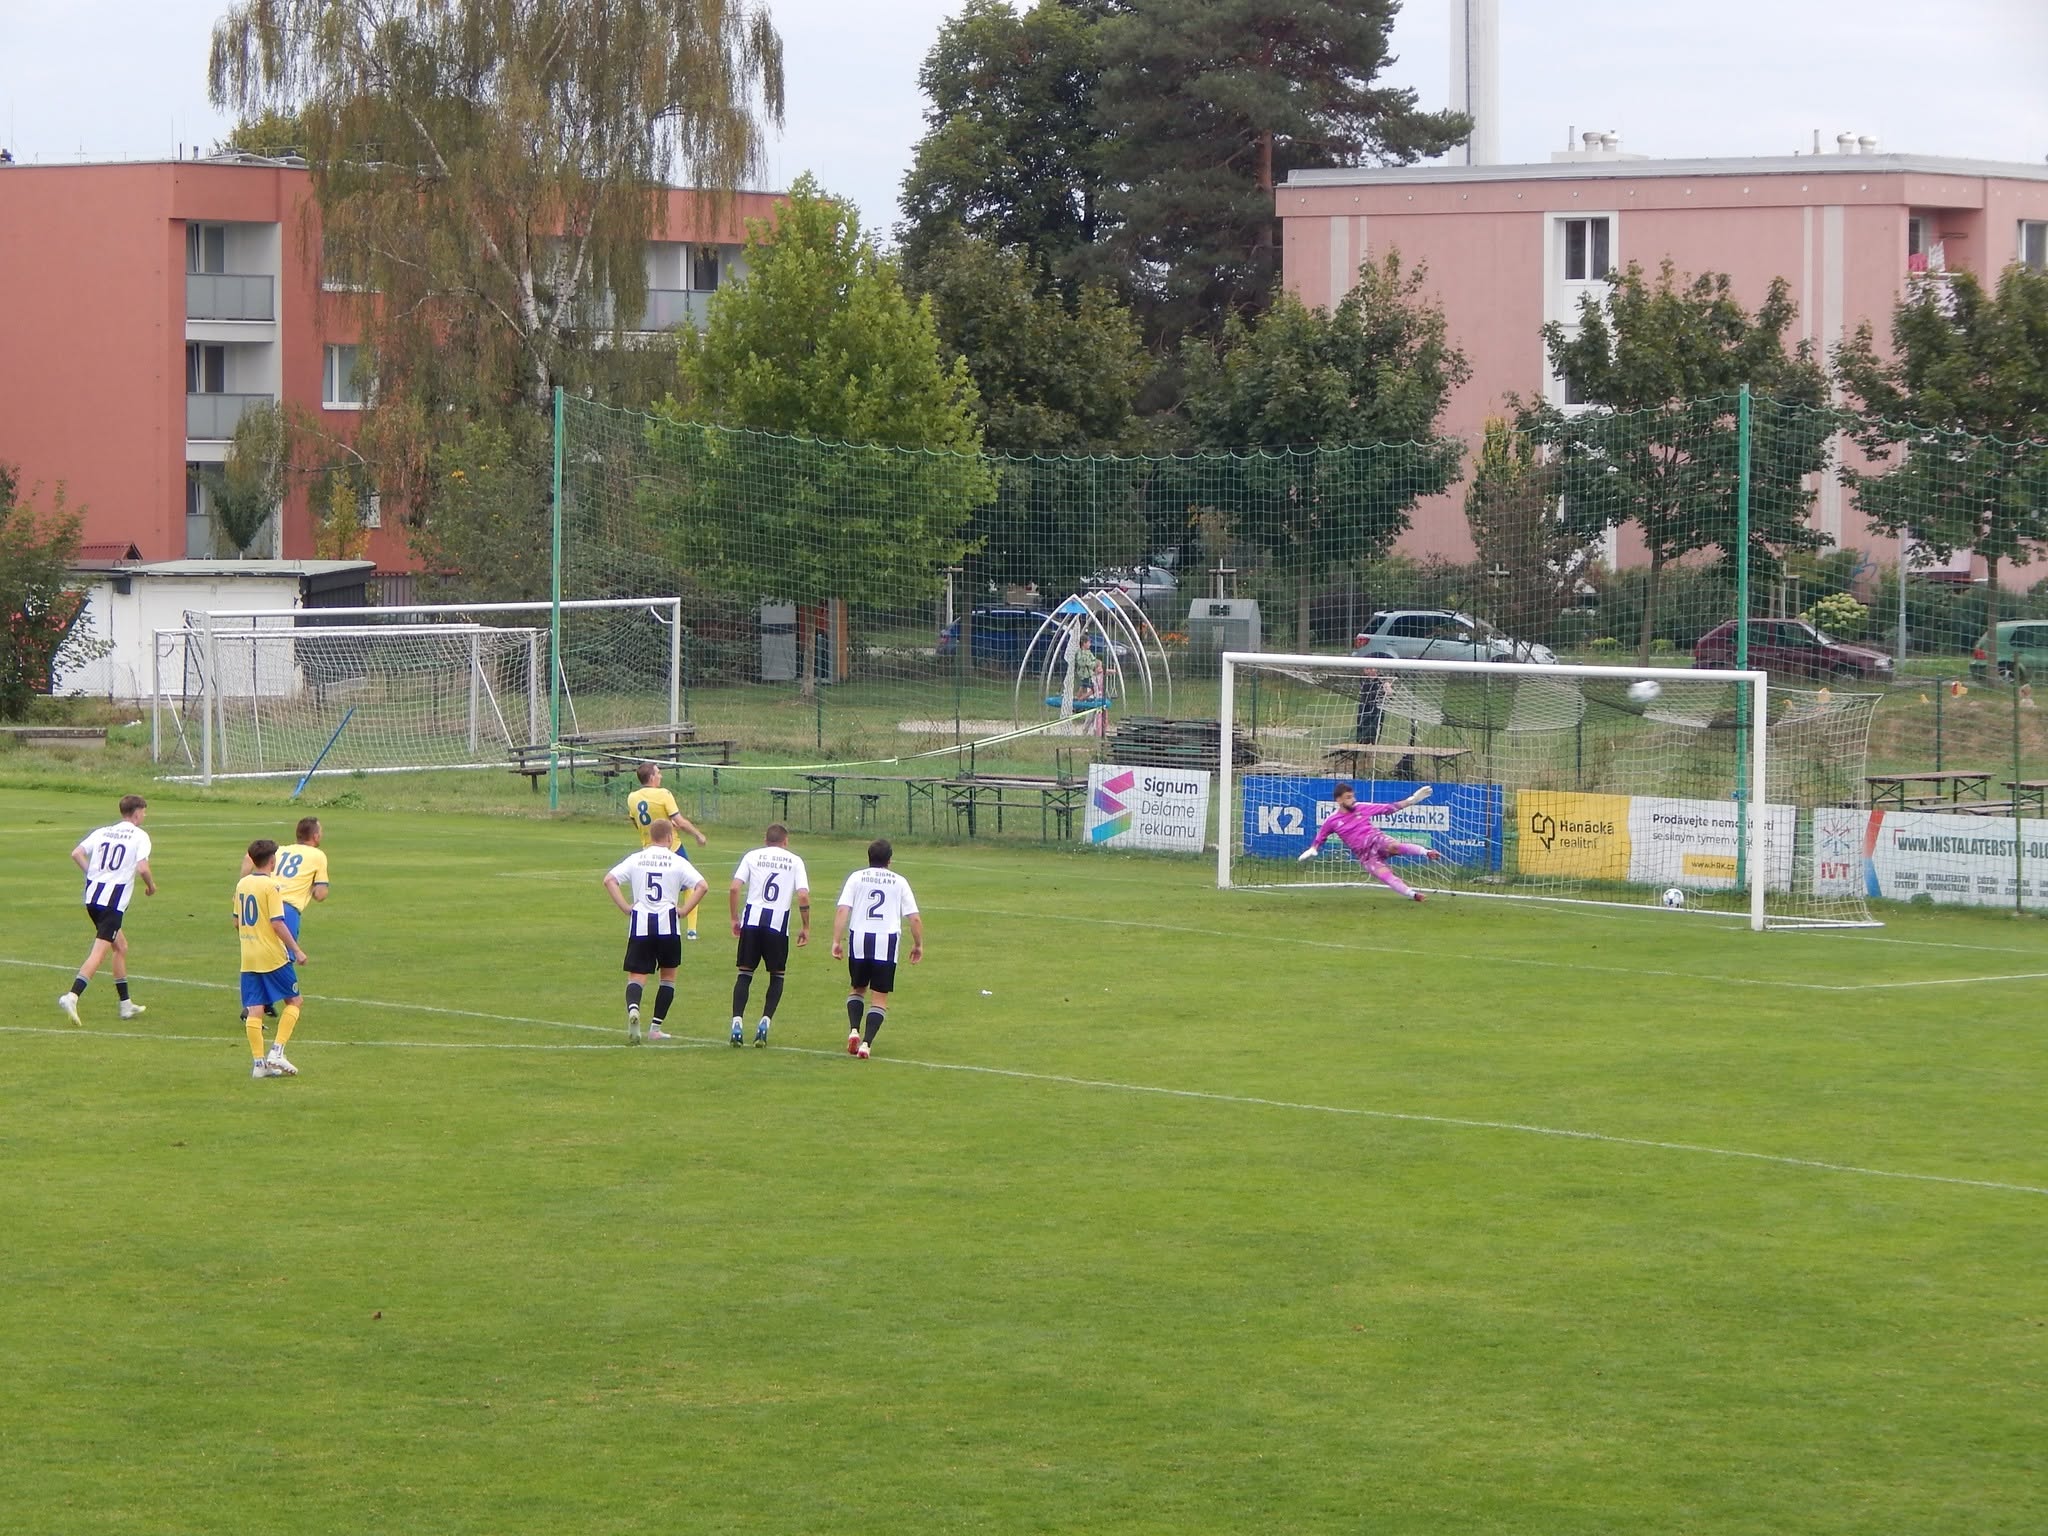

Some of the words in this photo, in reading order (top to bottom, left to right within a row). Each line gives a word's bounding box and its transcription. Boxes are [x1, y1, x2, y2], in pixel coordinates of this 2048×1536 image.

[1144, 776, 1198, 797] Signum
[638, 801, 651, 826] 8
[1141, 801, 1195, 818] Děláme
[1258, 806, 1304, 835] K2
[1429, 812, 1445, 825] K2
[1653, 814, 1709, 828] Prodávejte
[1140, 822, 1196, 838] reklamu
[1560, 820, 1615, 835] Hanácká
[1560, 838, 1597, 849] realitní
[100, 842, 126, 871] 10
[276, 851, 304, 878] 18
[1821, 862, 1850, 880] IVT
[646, 872, 663, 902] 5
[763, 872, 780, 903] 6
[239, 893, 259, 927] 10
[866, 889, 886, 920] 2
